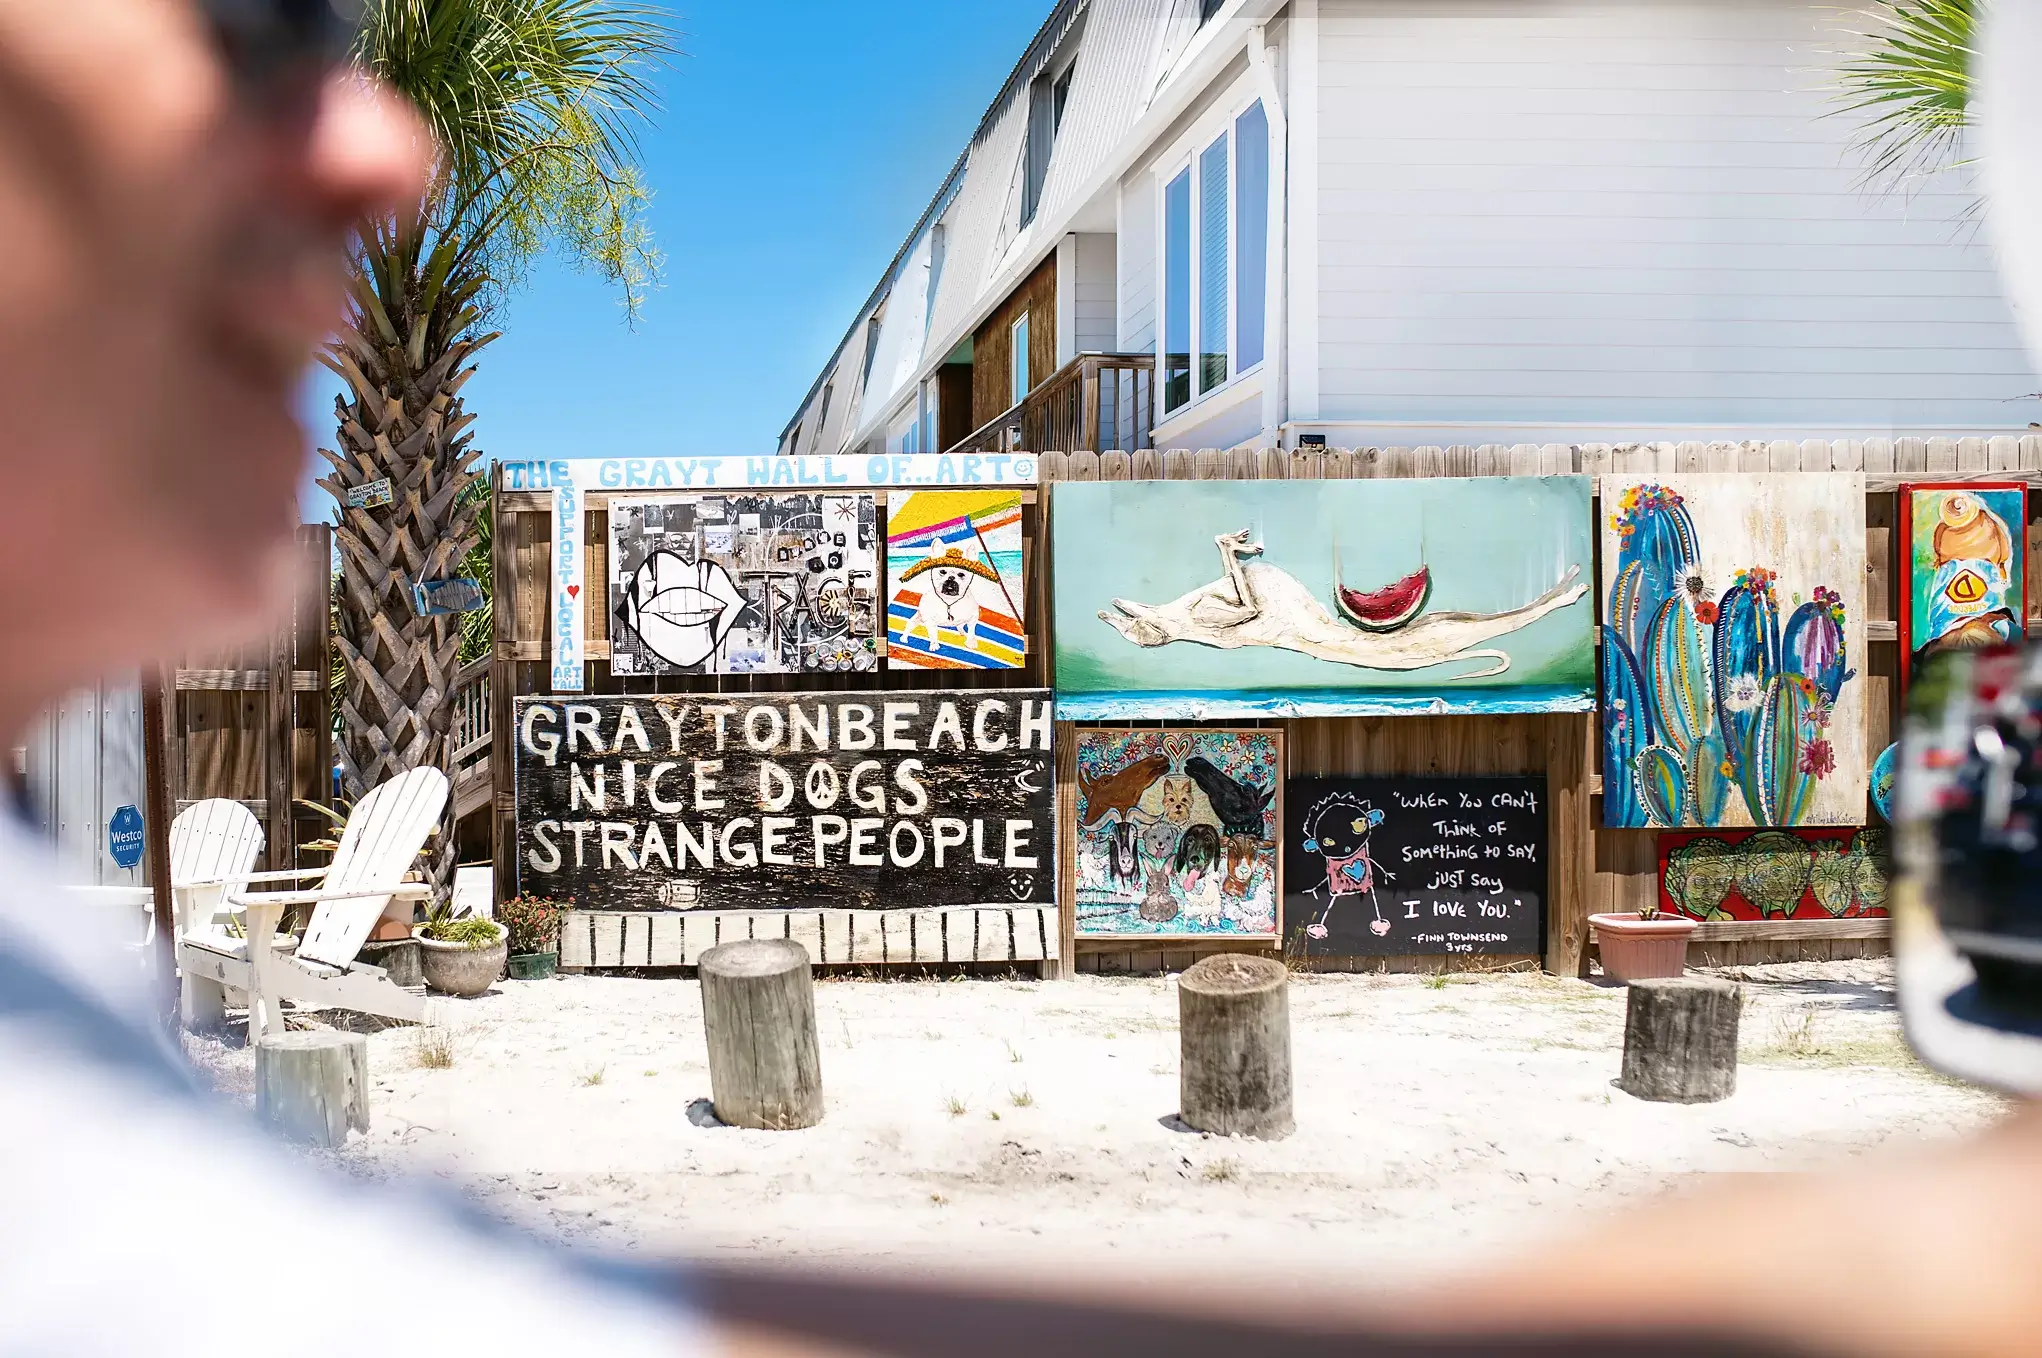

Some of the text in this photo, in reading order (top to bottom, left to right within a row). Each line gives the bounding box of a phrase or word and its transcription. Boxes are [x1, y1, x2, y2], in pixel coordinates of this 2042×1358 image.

[506, 460, 573, 489] THE
[599, 459, 722, 488] GRAYT
[746, 457, 847, 486] WALL
[558, 486, 575, 585] SUPPORT
[558, 593, 573, 666] LOCAL
[553, 666, 582, 678] ART
[569, 758, 928, 815] NICE DOGS
[111, 830, 142, 844] Westco
[116, 843, 139, 852] SECURITY
[527, 814, 1038, 873] STRANGE PEOPLE
[1402, 900, 1421, 919] I
[1447, 931, 1508, 943] TOWNSEND
